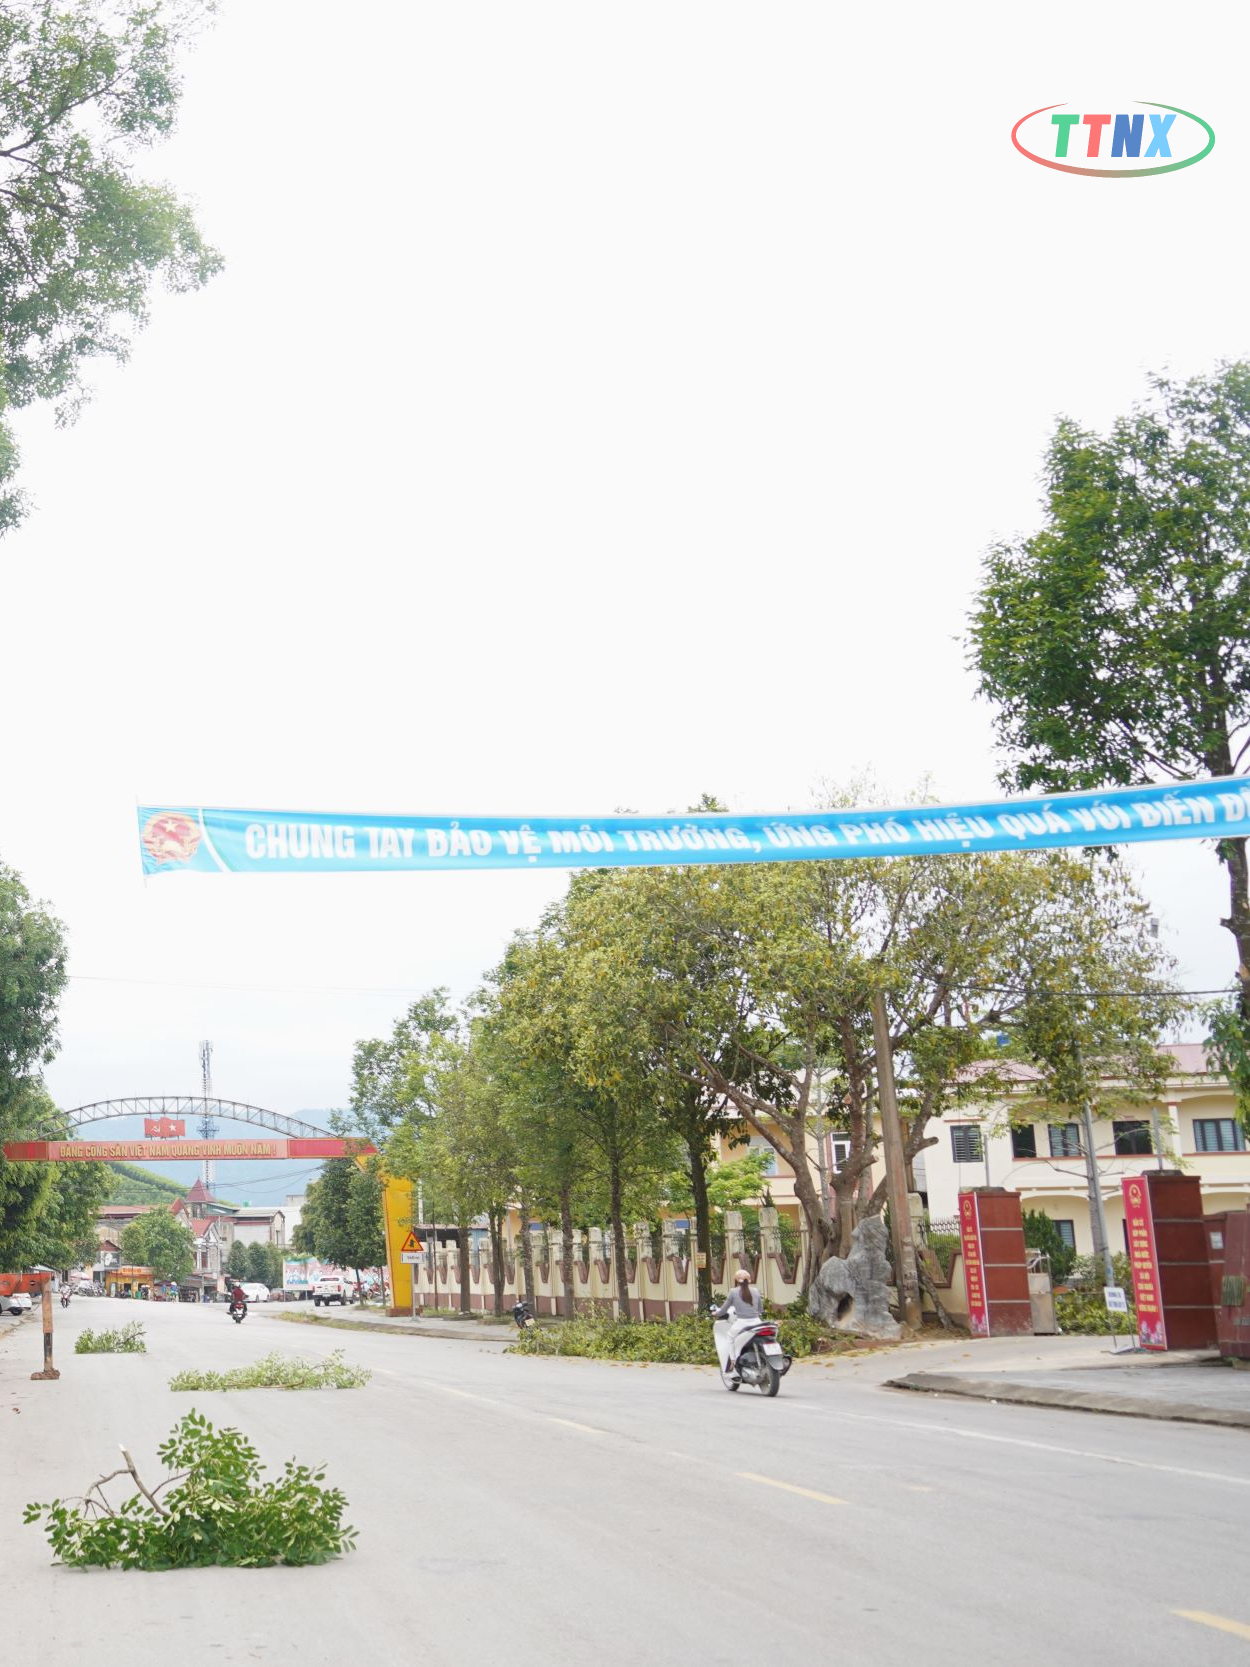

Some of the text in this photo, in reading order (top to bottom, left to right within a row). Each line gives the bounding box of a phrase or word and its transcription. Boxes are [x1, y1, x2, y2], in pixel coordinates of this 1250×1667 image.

[245, 823, 356, 859] CHUNG
[364, 826, 415, 858] TAY
[425, 821, 492, 857] BẢO
[497, 824, 542, 863] VỆ
[547, 824, 615, 853] MÔI
[617, 823, 762, 853] TRƯỜNG,
[763, 820, 839, 848] ỨNG
[839, 815, 911, 845] PHÓ
[913, 811, 995, 848] HIỆU
[1068, 801, 1132, 831] VỚI
[1132, 789, 1215, 827] BIẾN
[60, 1143, 83, 1158] ĐẢNG
[110, 1143, 128, 1157] SẢN
[129, 1144, 147, 1159] VIỆT
[149, 1145, 169, 1157] NAM
[171, 1144, 200, 1158] QUANG
[201, 1144, 220, 1156] VINH
[224, 1143, 248, 1156] MUÔN
[250, 1143, 270, 1156] NĂM
